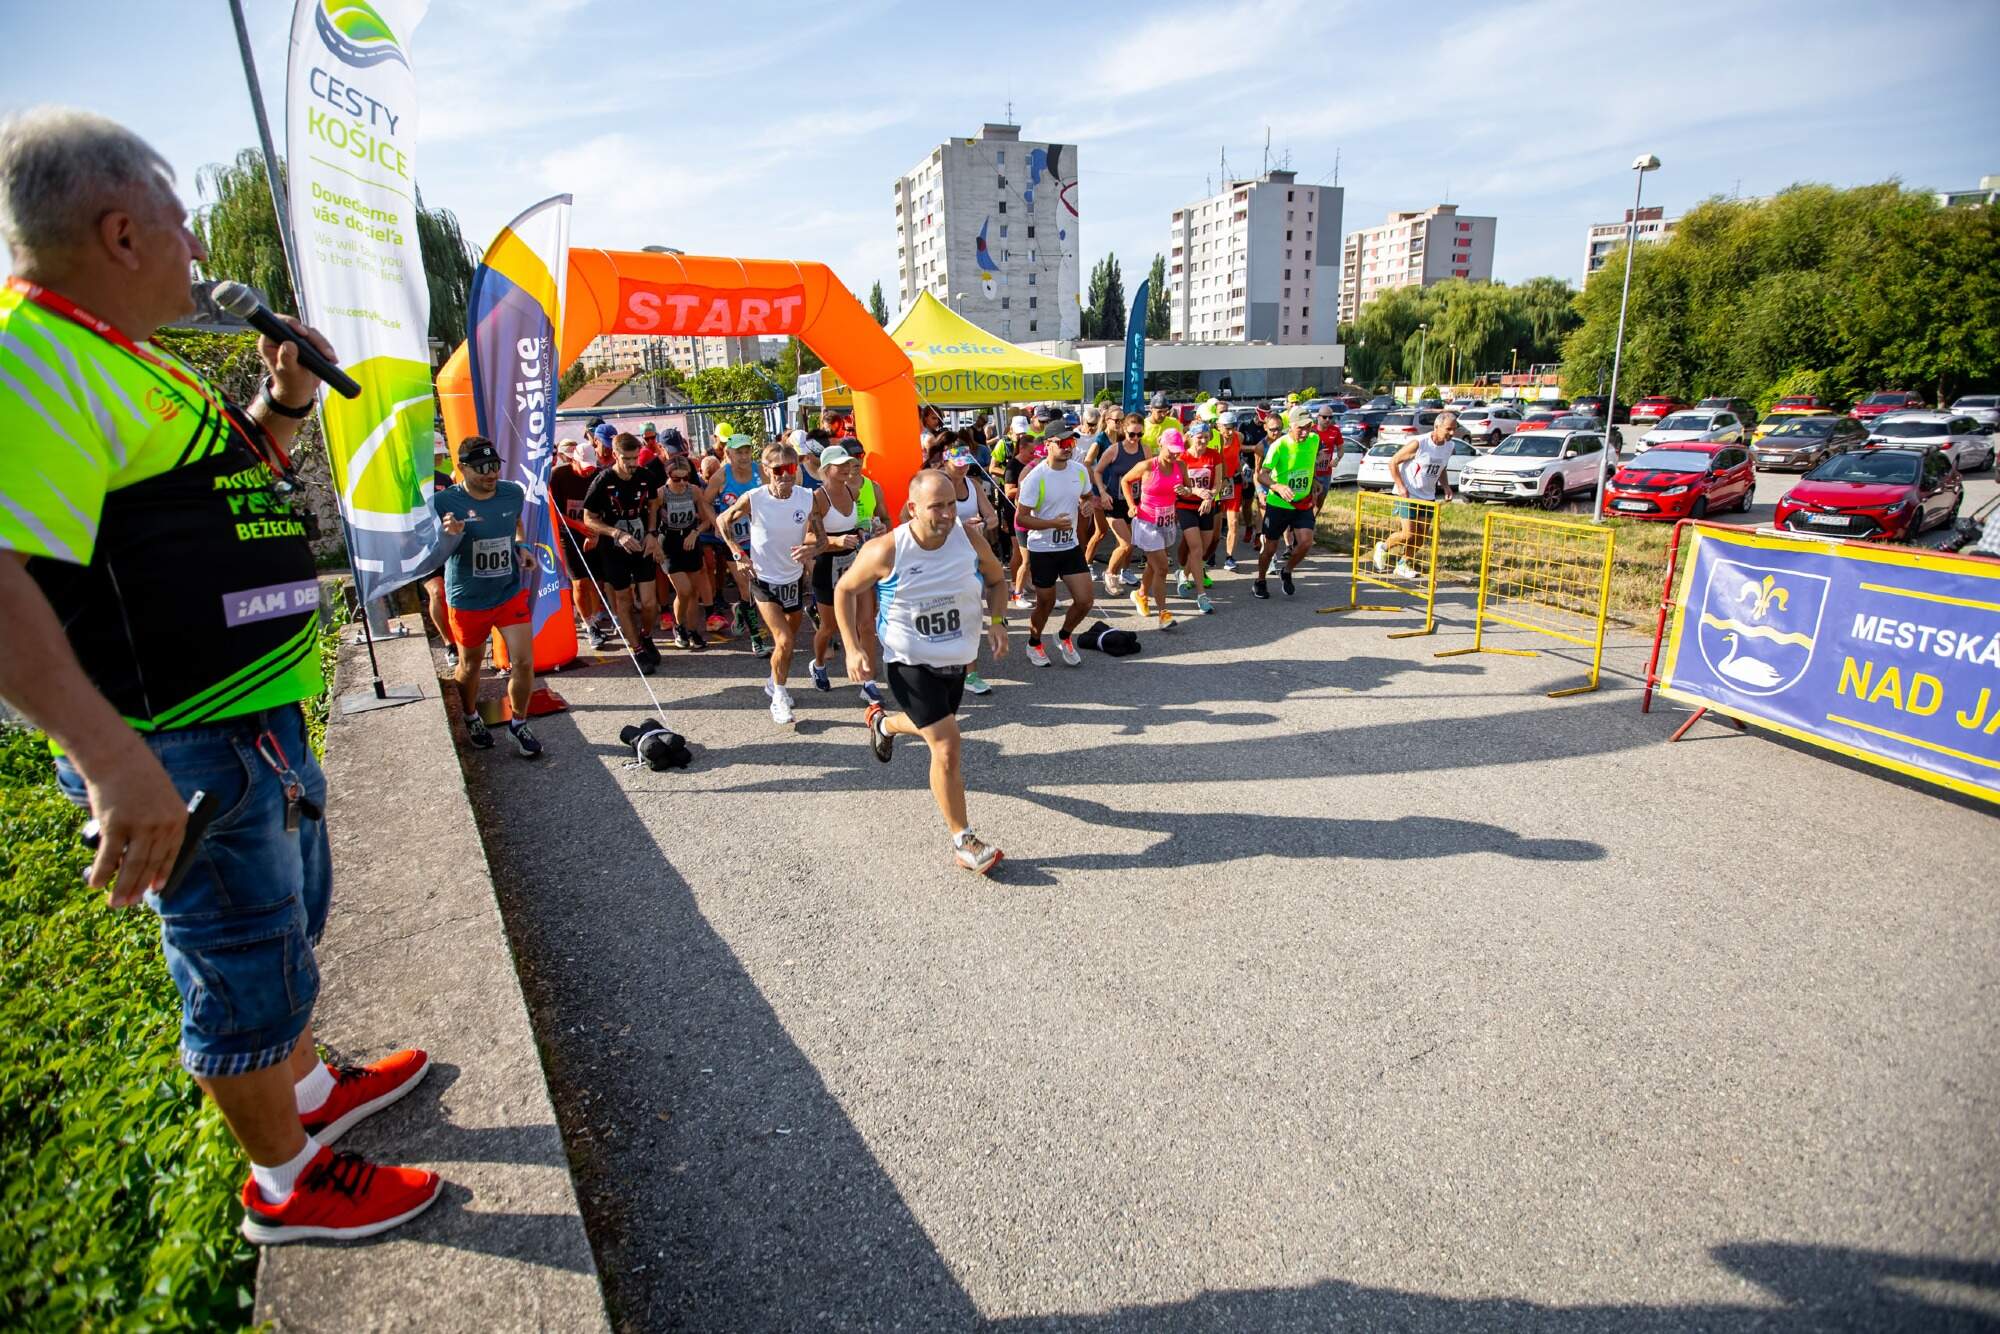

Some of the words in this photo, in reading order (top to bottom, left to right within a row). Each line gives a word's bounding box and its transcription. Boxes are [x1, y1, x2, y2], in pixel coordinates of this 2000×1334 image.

[310, 67, 399, 136] CESTY
[308, 106, 409, 180] KOŠICE
[312, 206, 340, 225] vás
[624, 291, 801, 333] START
[928, 342, 1005, 355] Košice
[1426, 463, 1441, 475] 113
[1288, 476, 1309, 489] 039
[670, 510, 693, 523] 024
[1052, 528, 1074, 544] 052
[476, 550, 509, 570] 003
[915, 608, 961, 636] 058
[1851, 613, 2000, 669] MESTSKÁ
[1837, 656, 1944, 716] NAD
